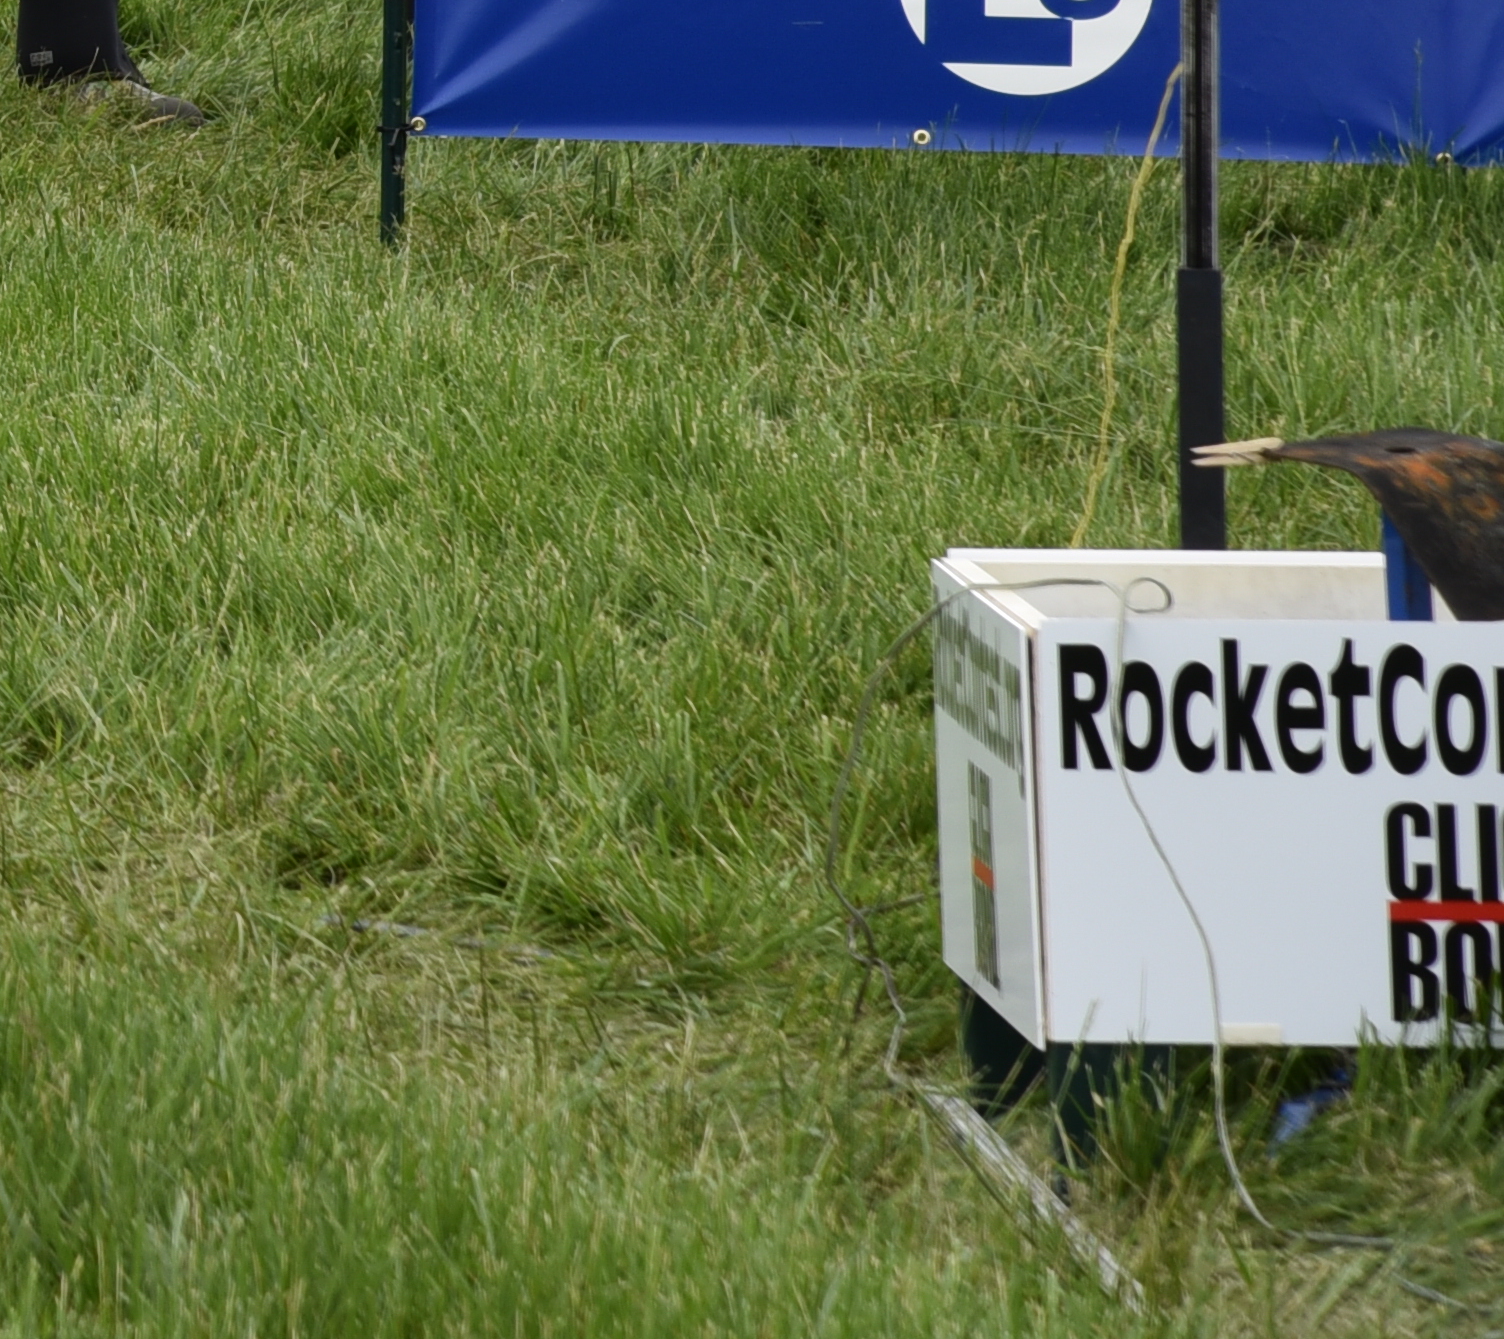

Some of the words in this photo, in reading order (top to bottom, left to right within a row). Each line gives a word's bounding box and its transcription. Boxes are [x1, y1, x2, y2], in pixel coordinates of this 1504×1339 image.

[1060, 640, 1504, 775] RocketCo
[1387, 803, 1504, 901] CLI
[1391, 923, 1504, 1025] BO
